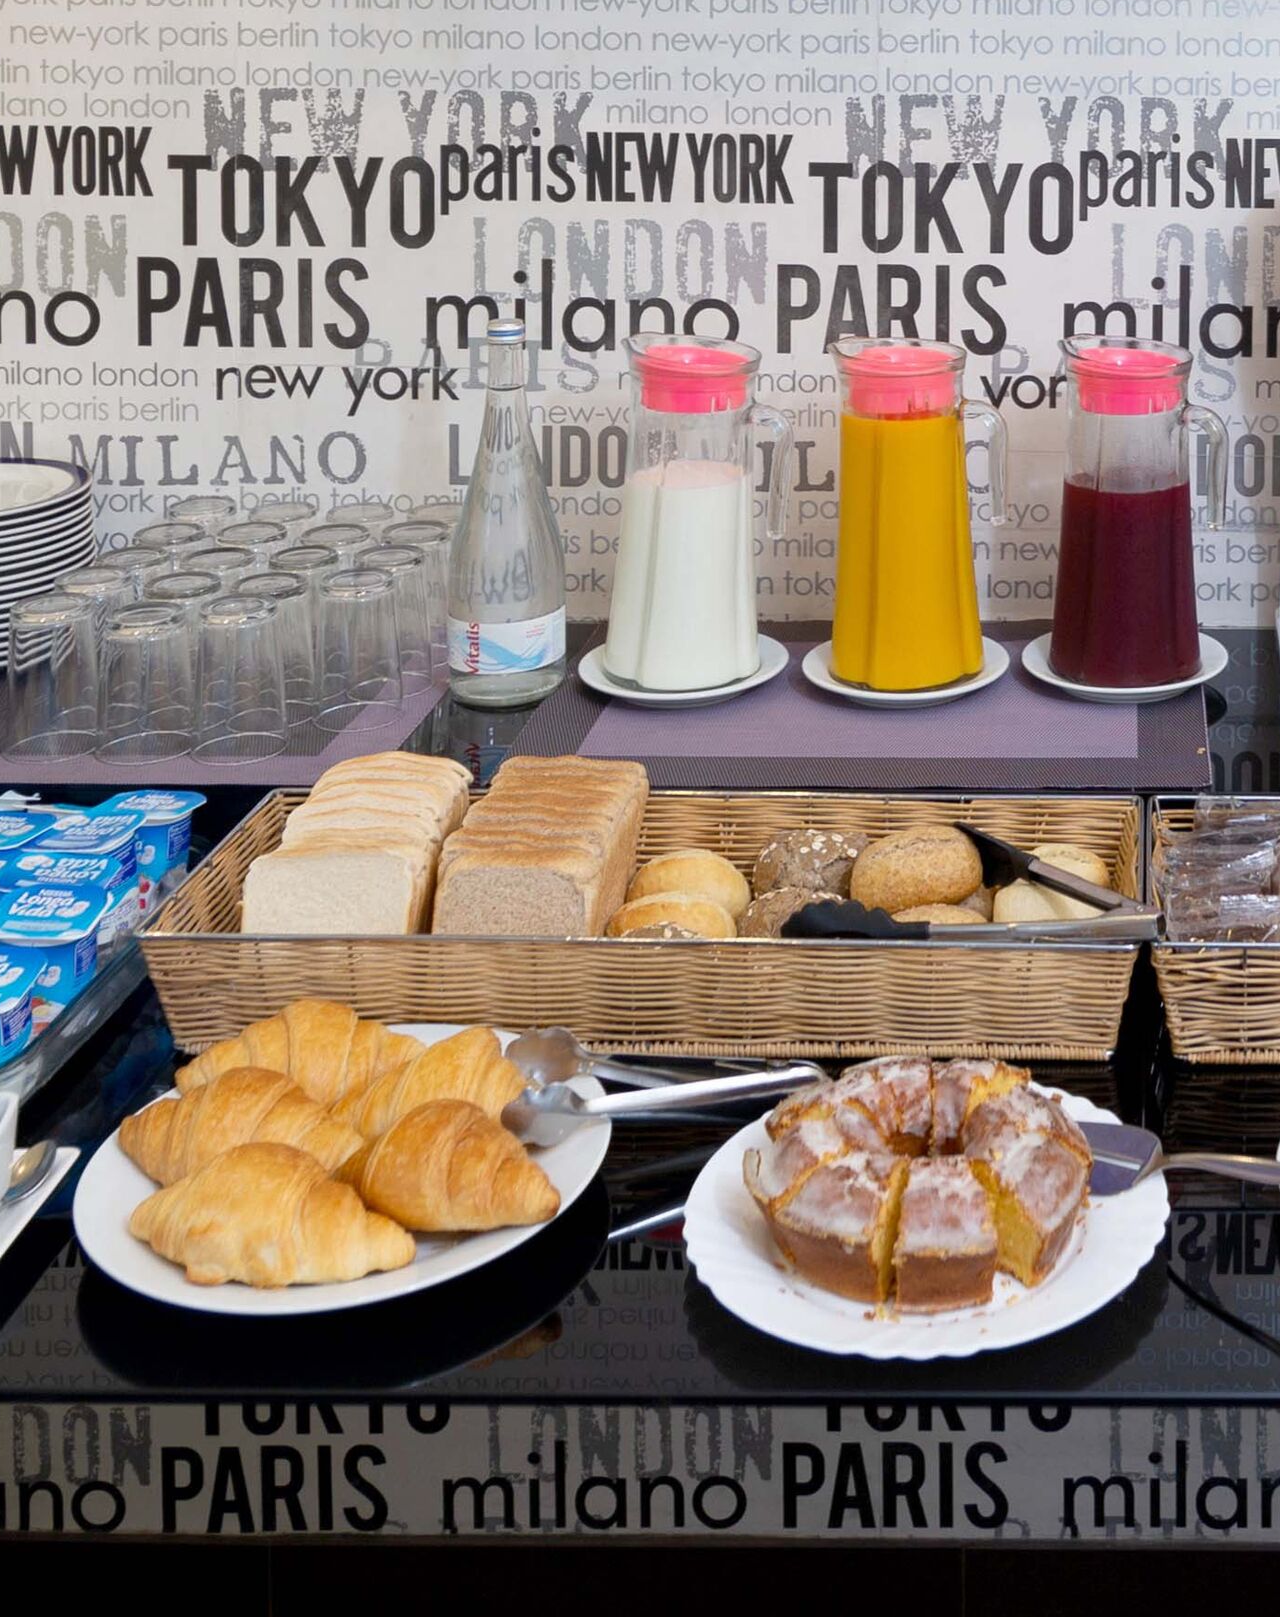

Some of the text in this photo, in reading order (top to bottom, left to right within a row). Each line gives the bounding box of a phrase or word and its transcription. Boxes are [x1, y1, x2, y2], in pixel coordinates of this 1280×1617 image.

[606, 101, 831, 126] milano london
[45, 125, 153, 197] YORK
[168, 154, 435, 250] TOKYO
[440, 127, 576, 215] paris
[586, 132, 794, 205] NEW YORK
[1079, 133, 1214, 221] paris
[809, 161, 1073, 255] TOKYO
[138, 256, 370, 350] PARIS
[41, 397, 109, 424] paris
[119, 397, 199, 423] berlin
[93, 362, 197, 387] london
[216, 347, 459, 417] new york
[464, 621, 480, 674] Vitalis
[161, 1444, 389, 1533] PARIS
[443, 1440, 747, 1533] milano
[782, 1441, 1010, 1530] PARIS
